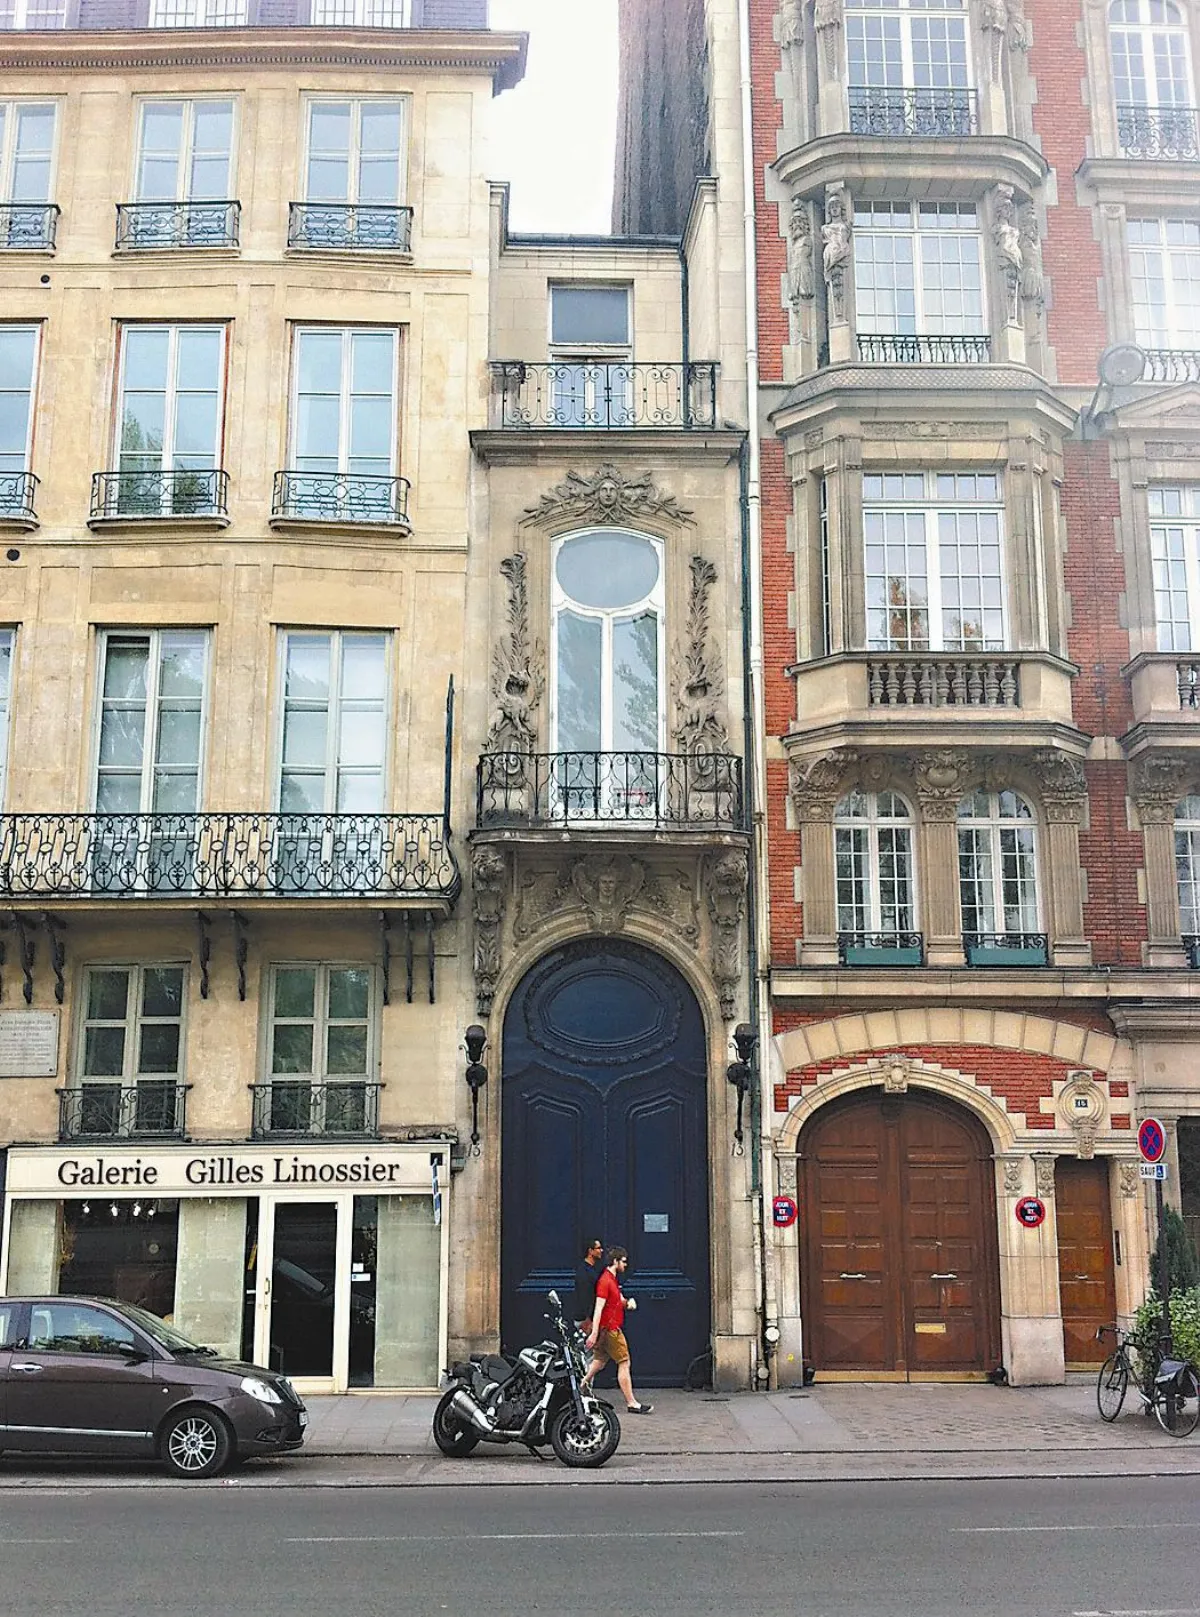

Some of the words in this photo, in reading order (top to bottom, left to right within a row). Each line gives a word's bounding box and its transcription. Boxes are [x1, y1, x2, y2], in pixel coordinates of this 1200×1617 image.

[57, 1158, 158, 1185] Galerie
[185, 1157, 264, 1184] Gilles
[273, 1156, 400, 1183] Linossier
[1141, 1166, 1156, 1176] SAUF
